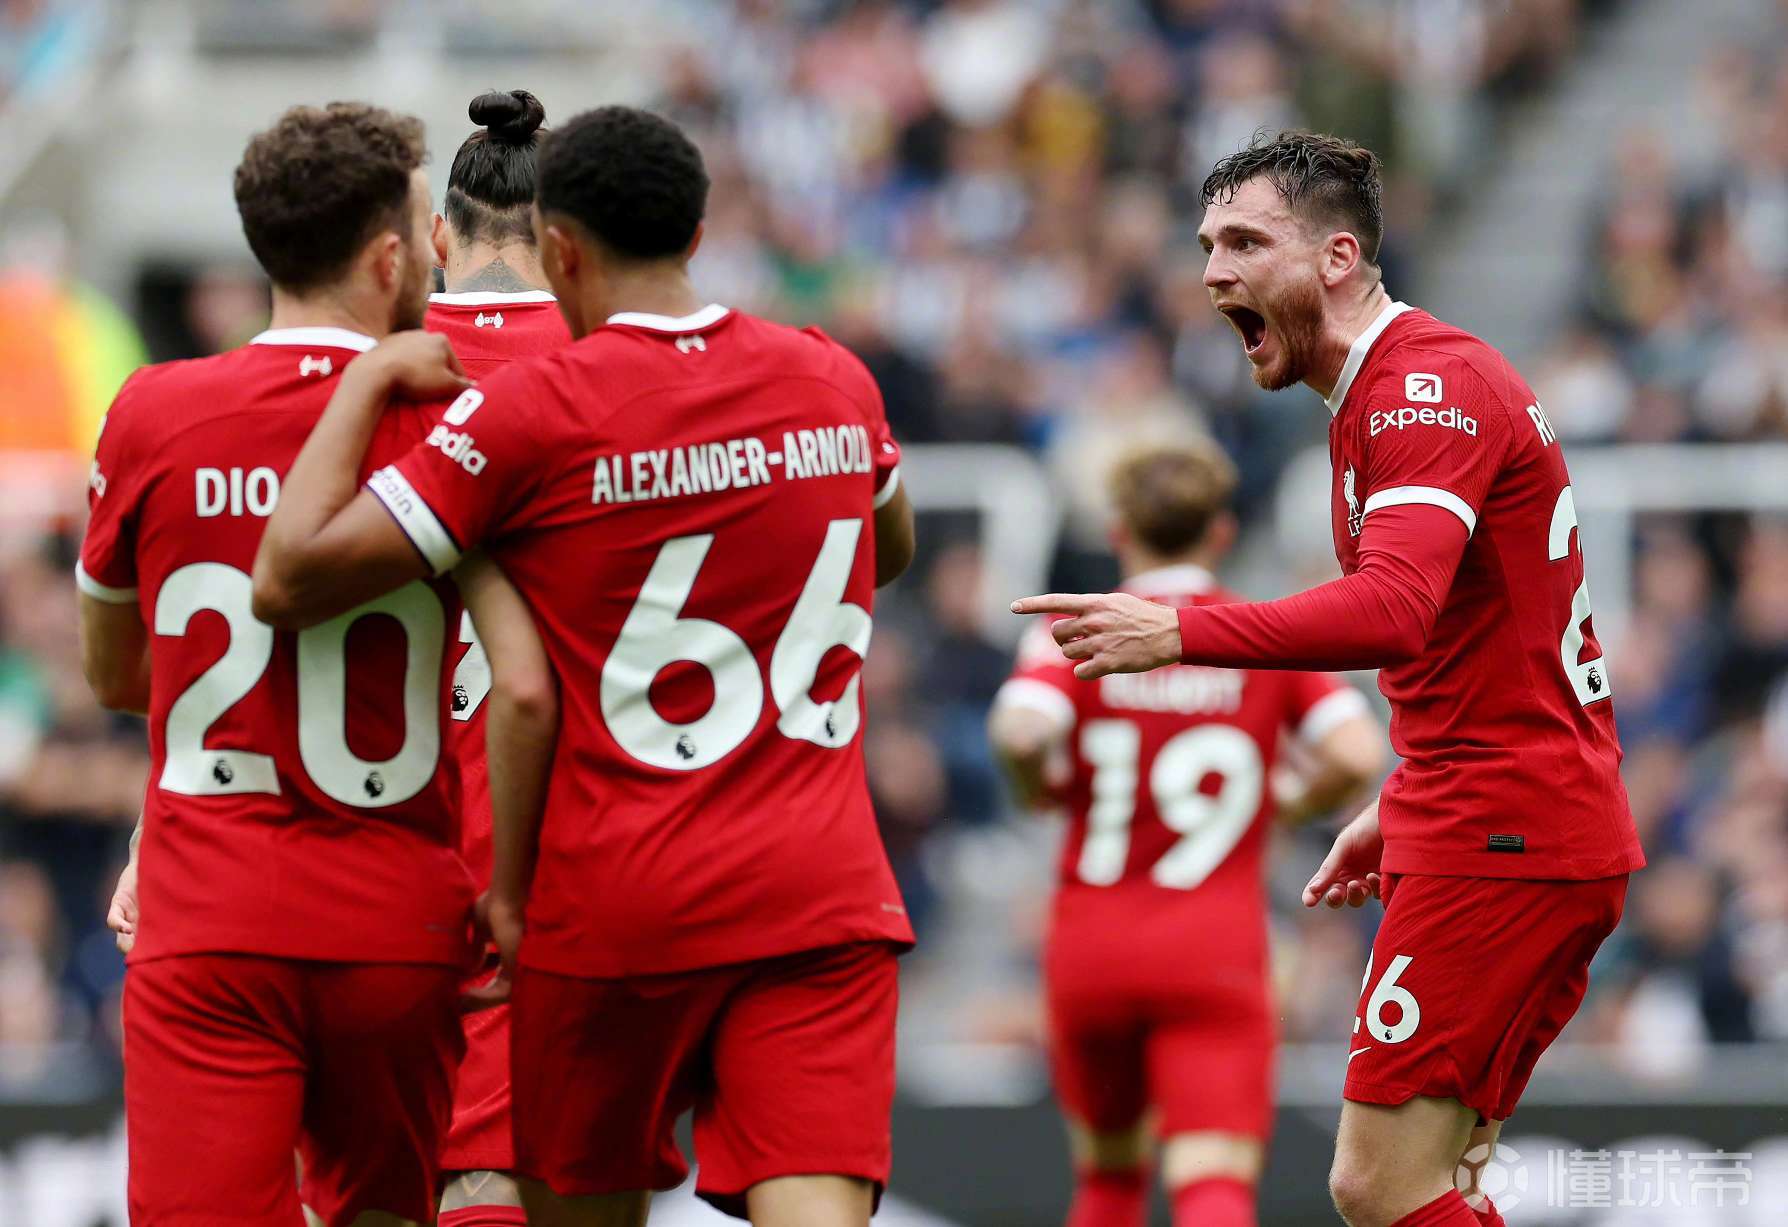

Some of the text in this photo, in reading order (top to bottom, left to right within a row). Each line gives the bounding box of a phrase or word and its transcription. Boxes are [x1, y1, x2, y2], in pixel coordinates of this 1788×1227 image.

[592, 425, 873, 504] ALEXANDER-ARNOLD
[1370, 407, 1478, 437] Expedia
[155, 561, 446, 808] 20
[600, 517, 873, 771] 66
[1077, 717, 1265, 891] 19
